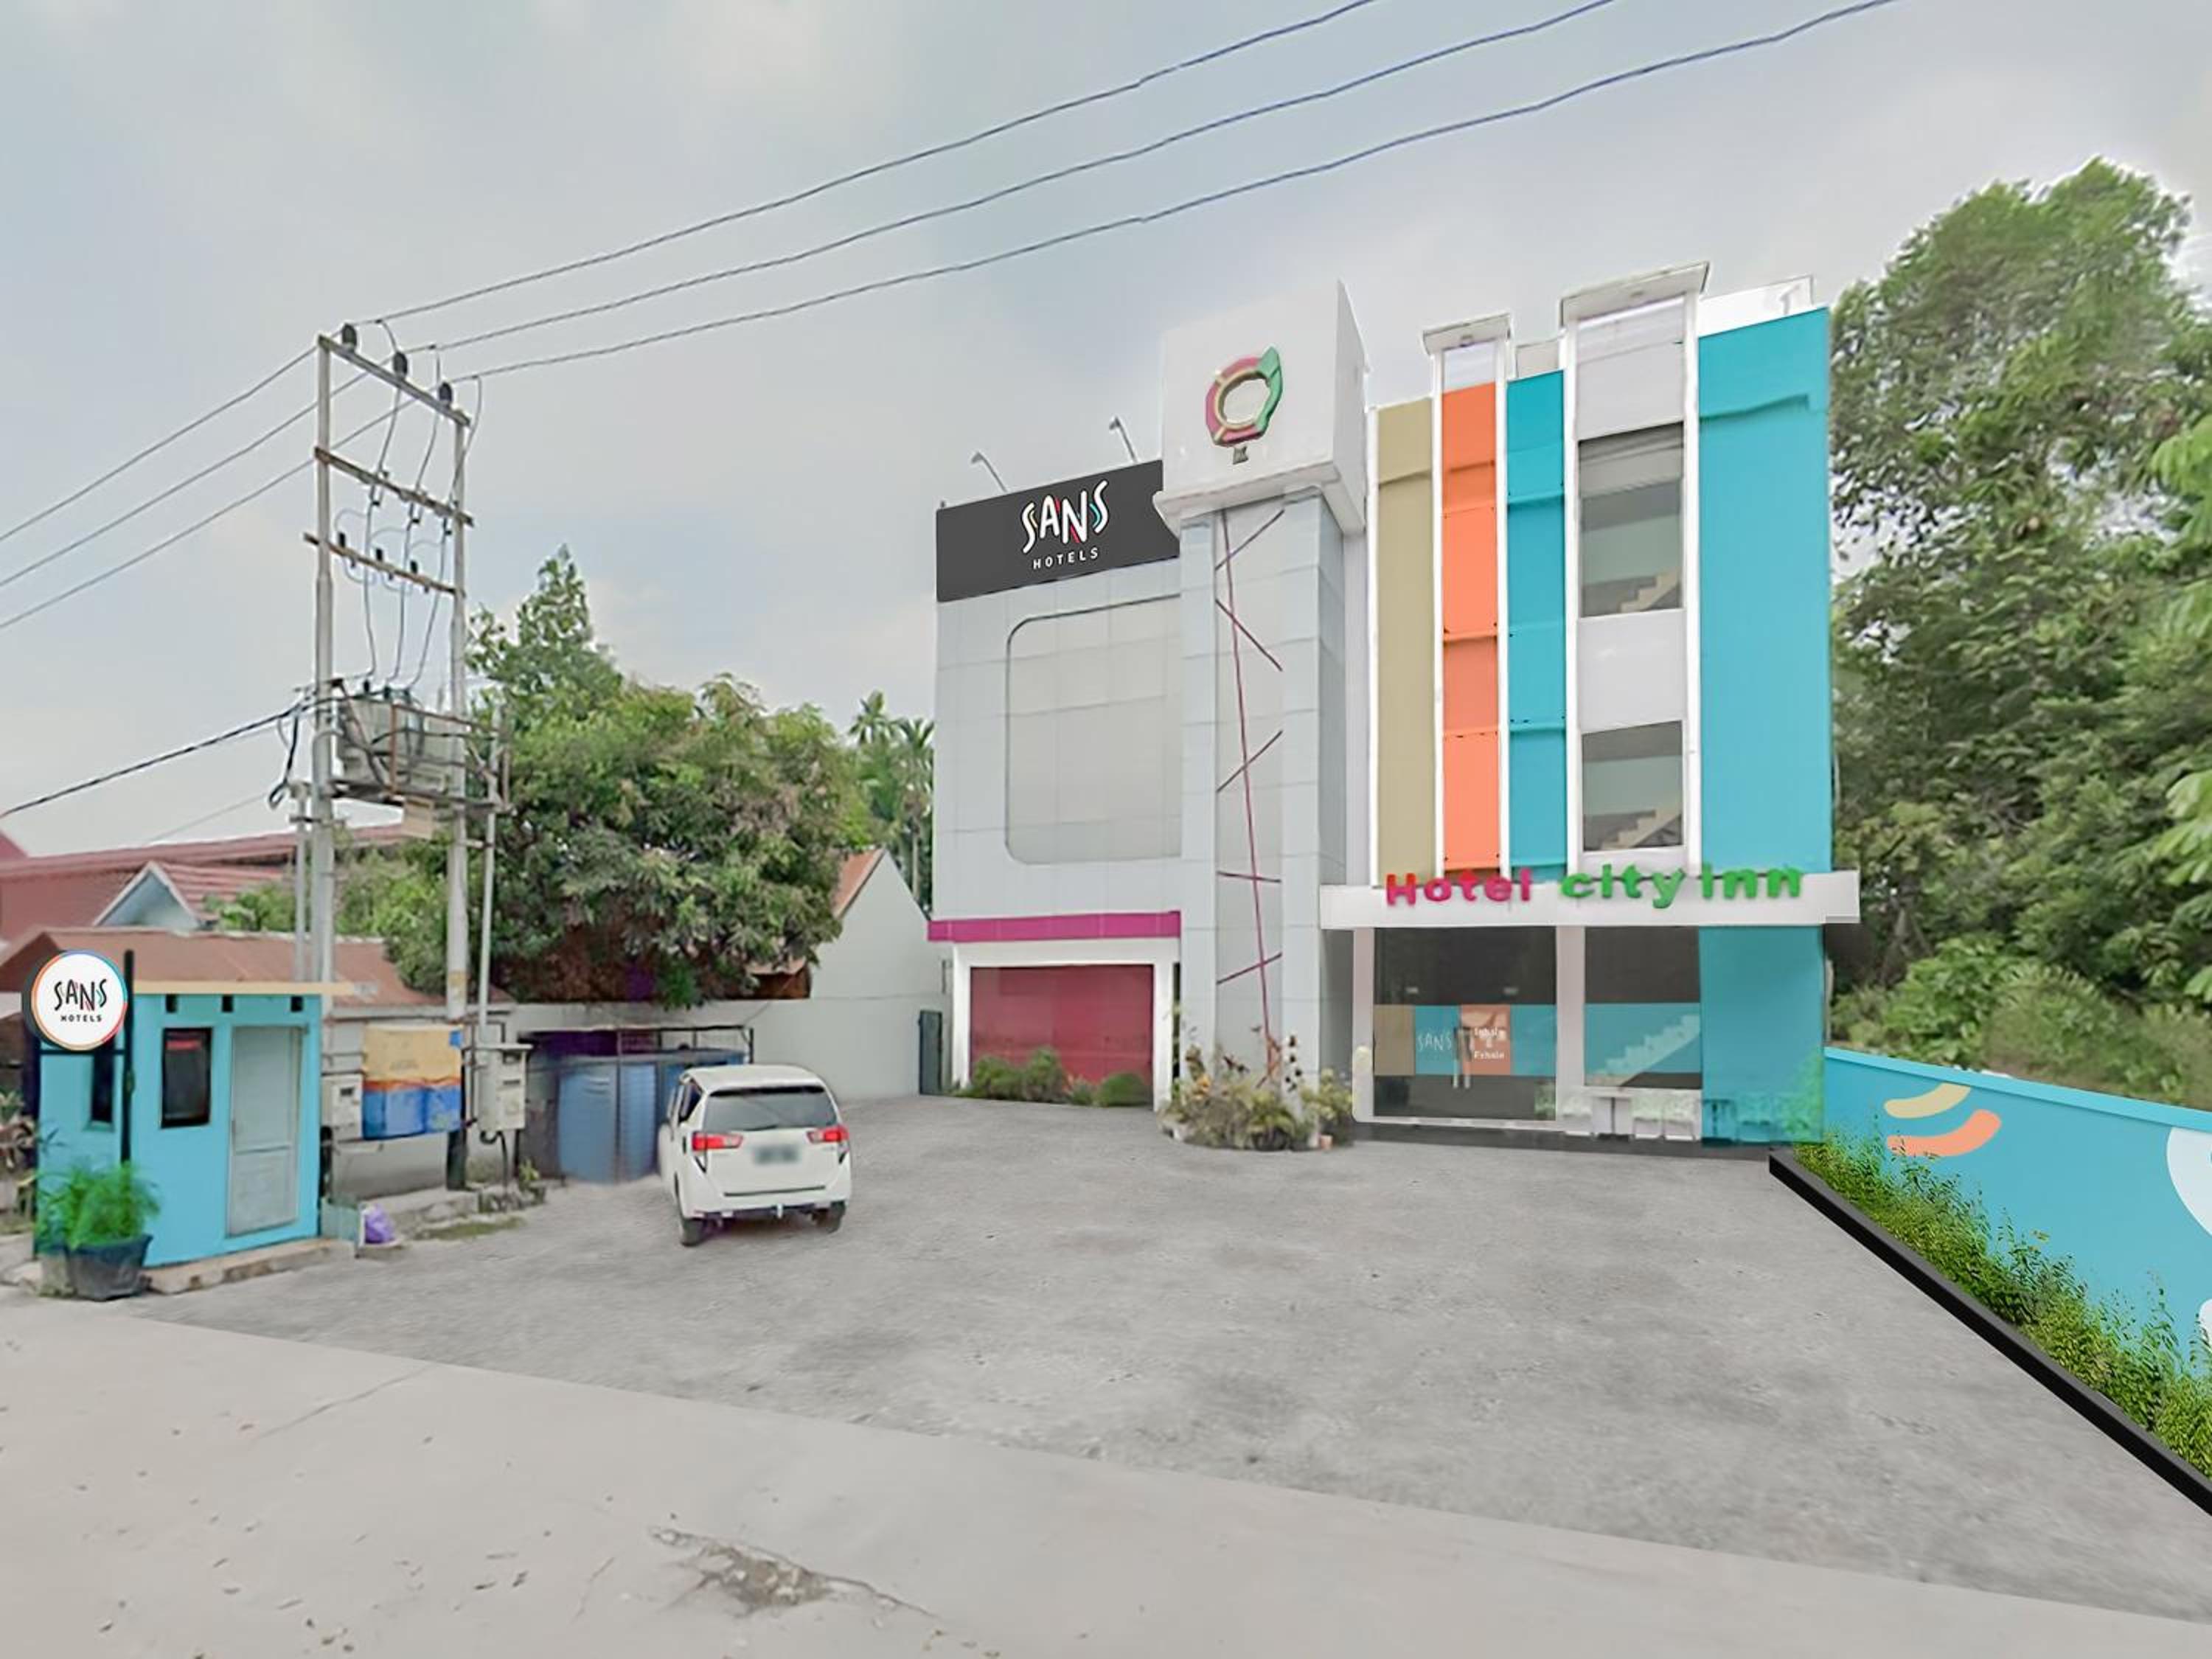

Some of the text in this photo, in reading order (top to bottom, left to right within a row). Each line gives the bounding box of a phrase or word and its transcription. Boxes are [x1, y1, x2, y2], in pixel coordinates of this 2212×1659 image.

[1021, 480, 1108, 553] SANS
[1032, 547, 1099, 570] HOTELS
[1385, 868, 1531, 906] Hotel
[54, 978, 107, 1011] SANS
[1417, 1033, 1453, 1051] SANS
